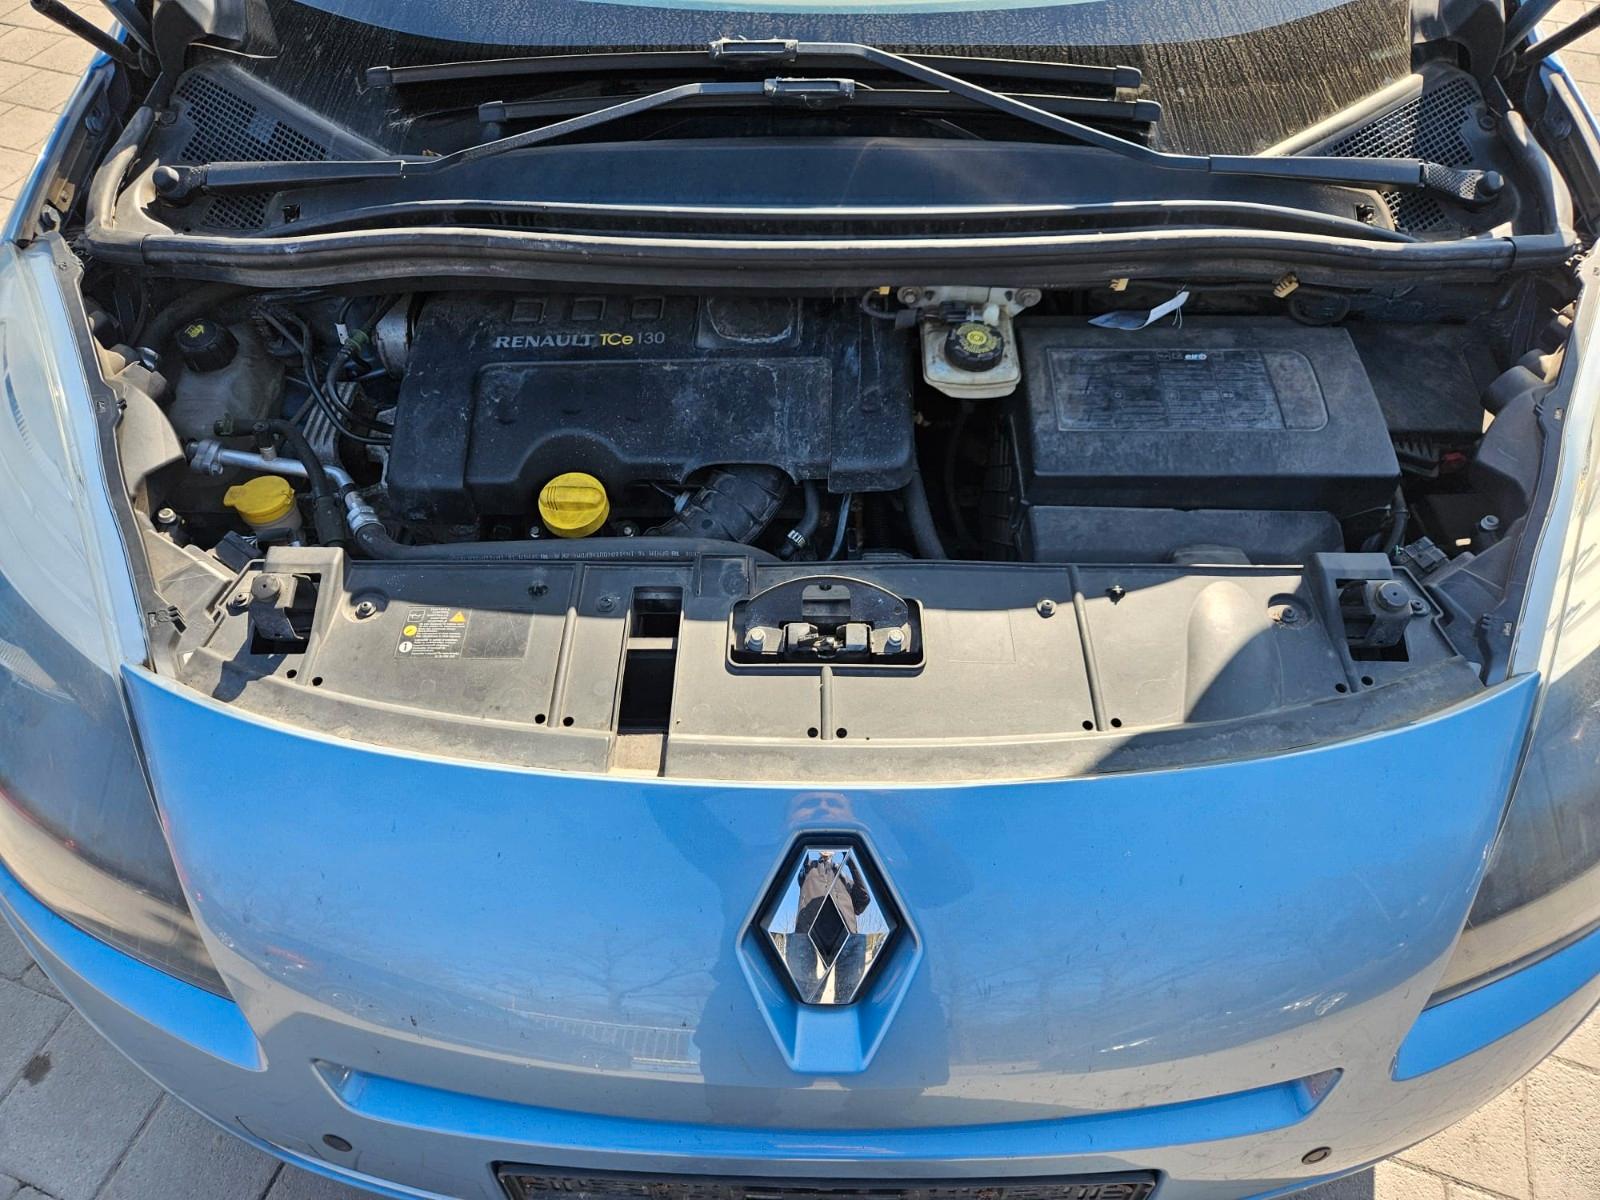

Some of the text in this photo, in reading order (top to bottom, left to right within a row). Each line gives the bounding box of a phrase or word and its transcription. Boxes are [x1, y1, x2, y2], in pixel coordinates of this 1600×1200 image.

[495, 332, 665, 348] RENAULT TCe 130
